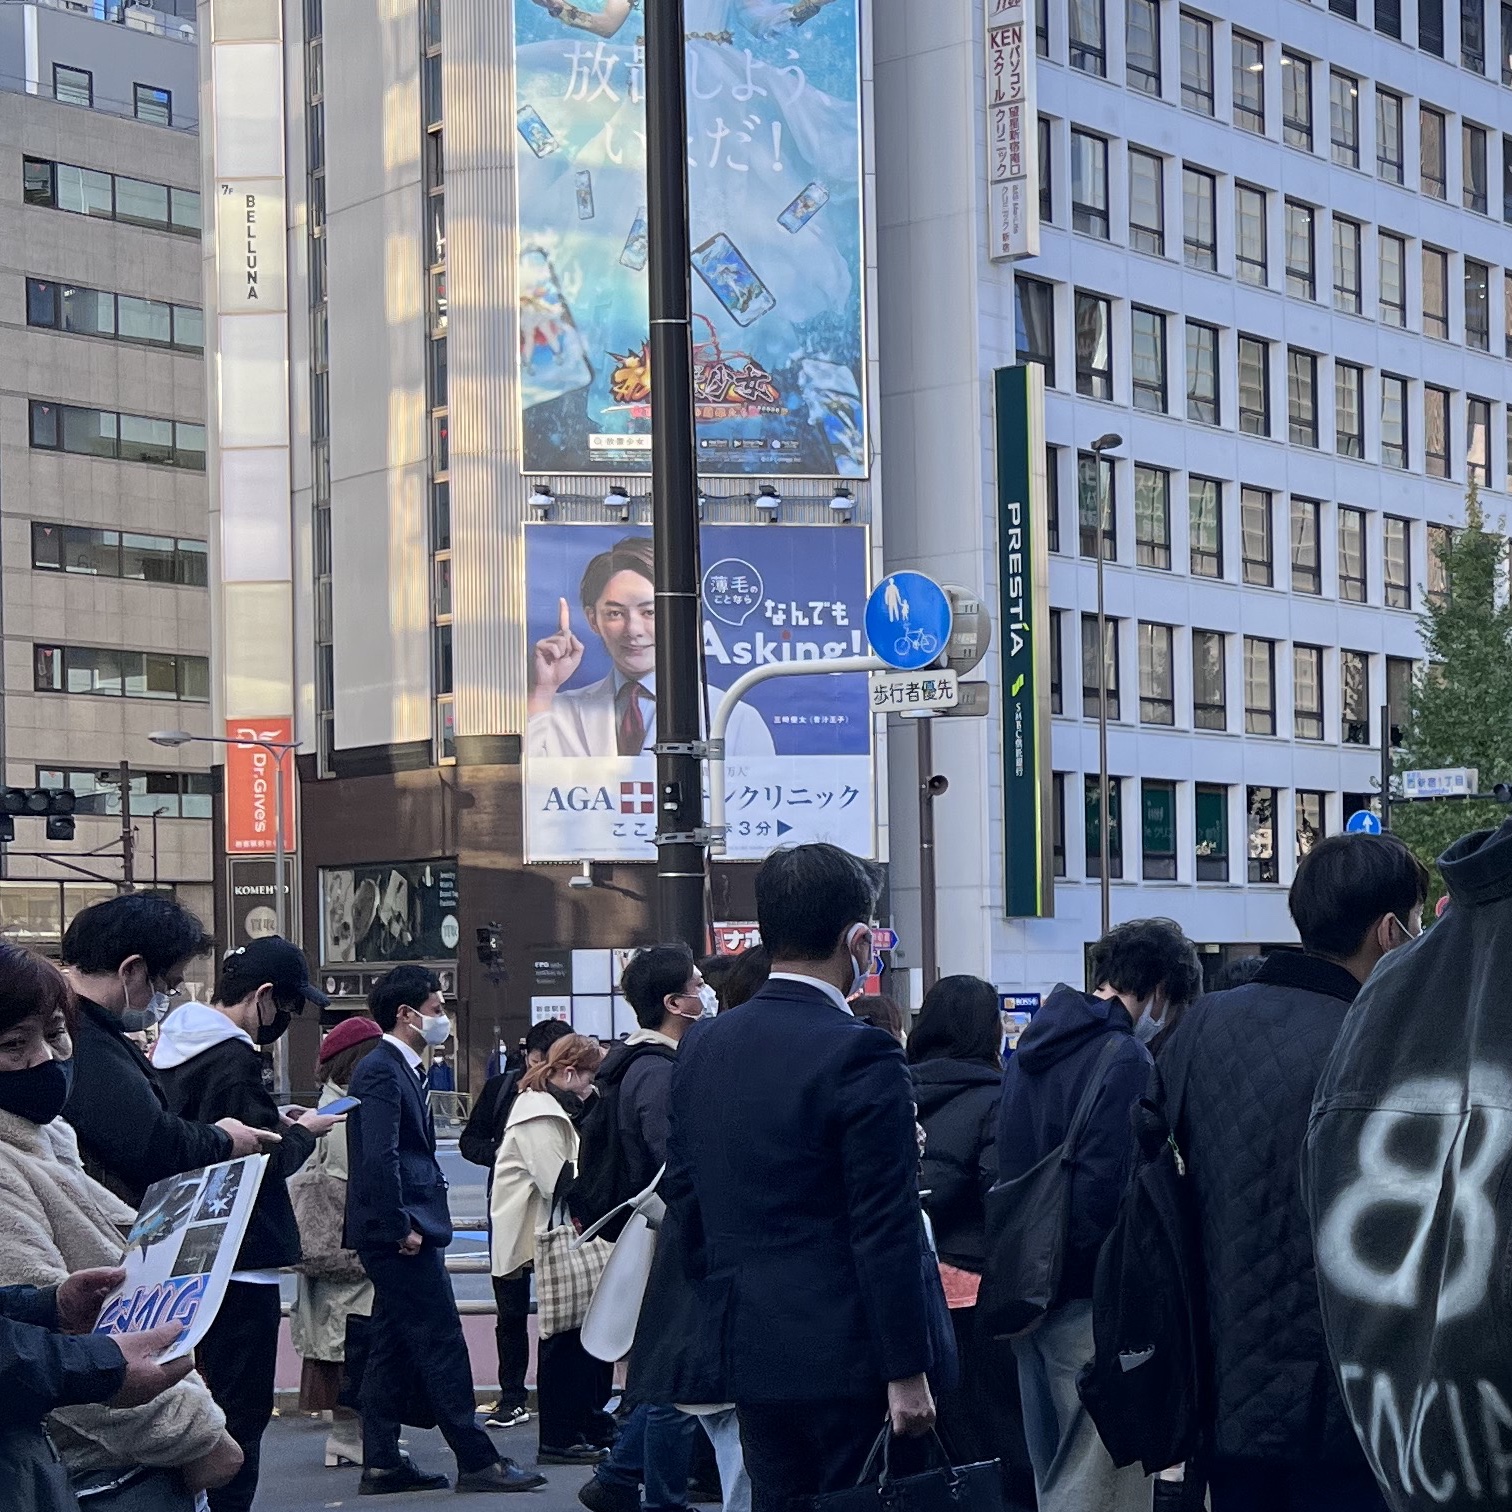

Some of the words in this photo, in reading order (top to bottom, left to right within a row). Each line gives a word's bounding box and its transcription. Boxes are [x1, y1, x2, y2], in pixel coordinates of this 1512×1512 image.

[990, 26, 1022, 49] KEN
[994, 49, 1006, 102] スクール
[1010, 44, 1021, 99] パソコン
[996, 108, 1007, 178] クリニック
[221, 184, 234, 195] 7F
[245, 194, 259, 300] BELLUNA
[714, 594, 753, 606] ことなら
[764, 599, 849, 626] なんでも
[702, 619, 862, 672] Asking!
[873, 679, 954, 706] 歩行者優先
[542, 786, 615, 811] AGA
